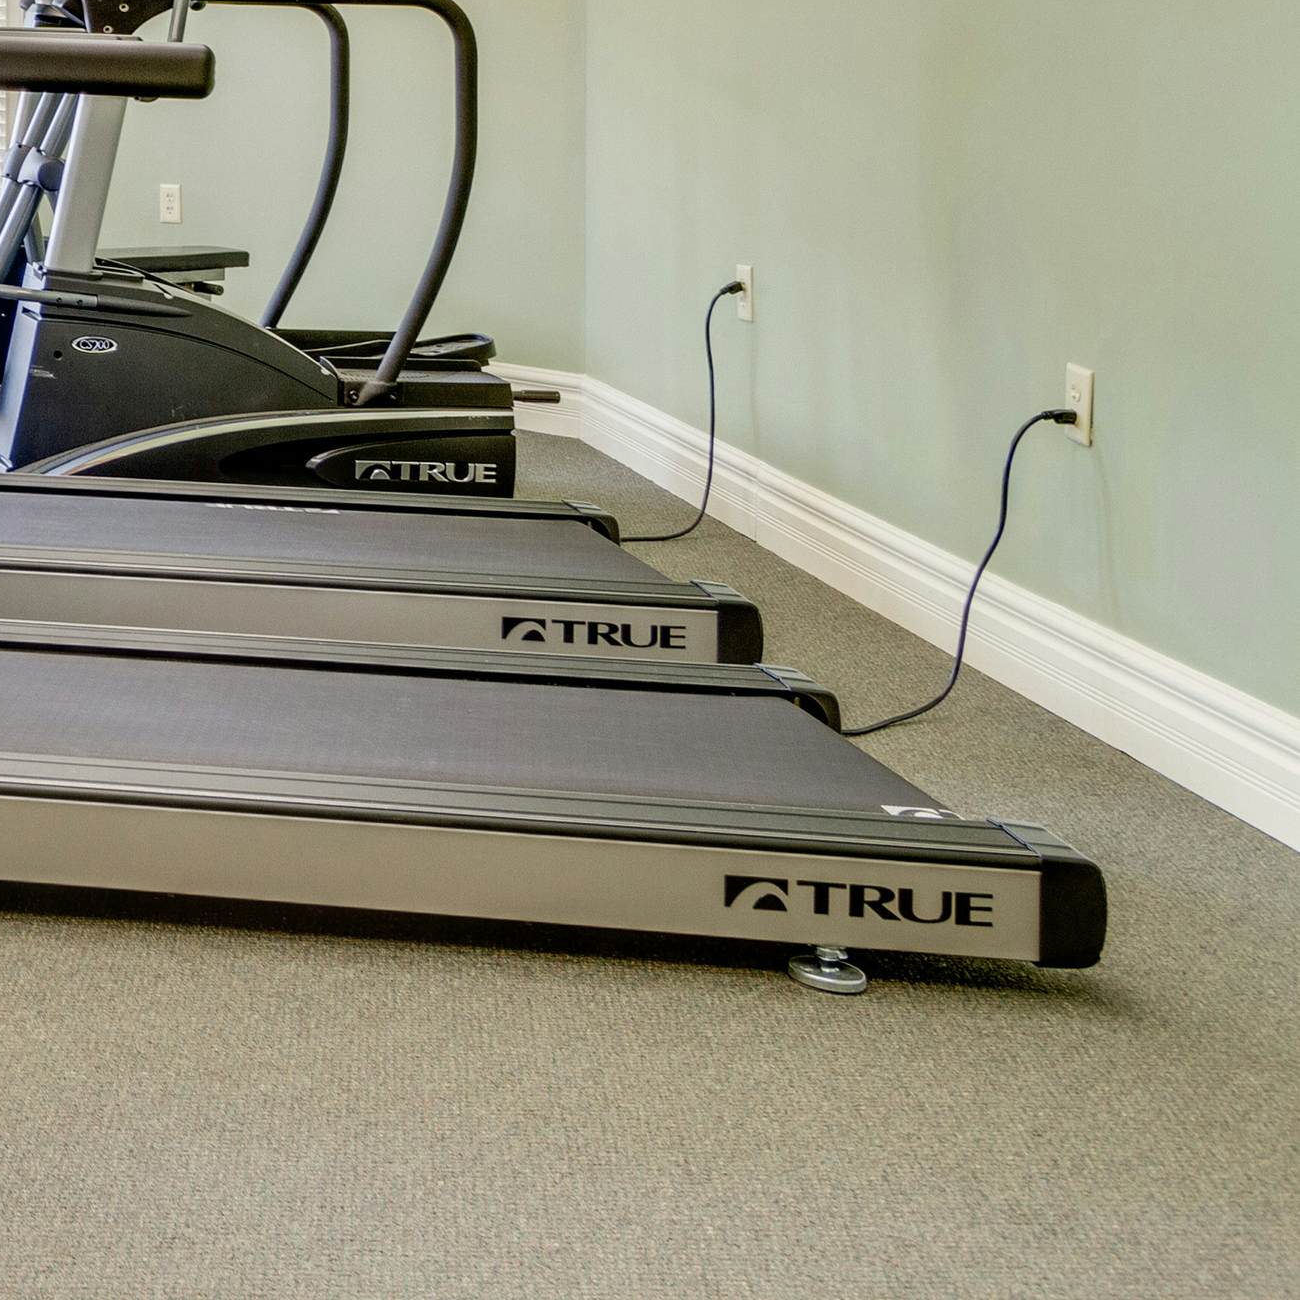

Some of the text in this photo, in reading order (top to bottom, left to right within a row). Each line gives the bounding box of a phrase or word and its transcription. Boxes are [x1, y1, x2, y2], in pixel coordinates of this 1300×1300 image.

[391, 460, 497, 483] TRUE
[551, 619, 687, 649] TRUE
[796, 880, 994, 927] TRUE
